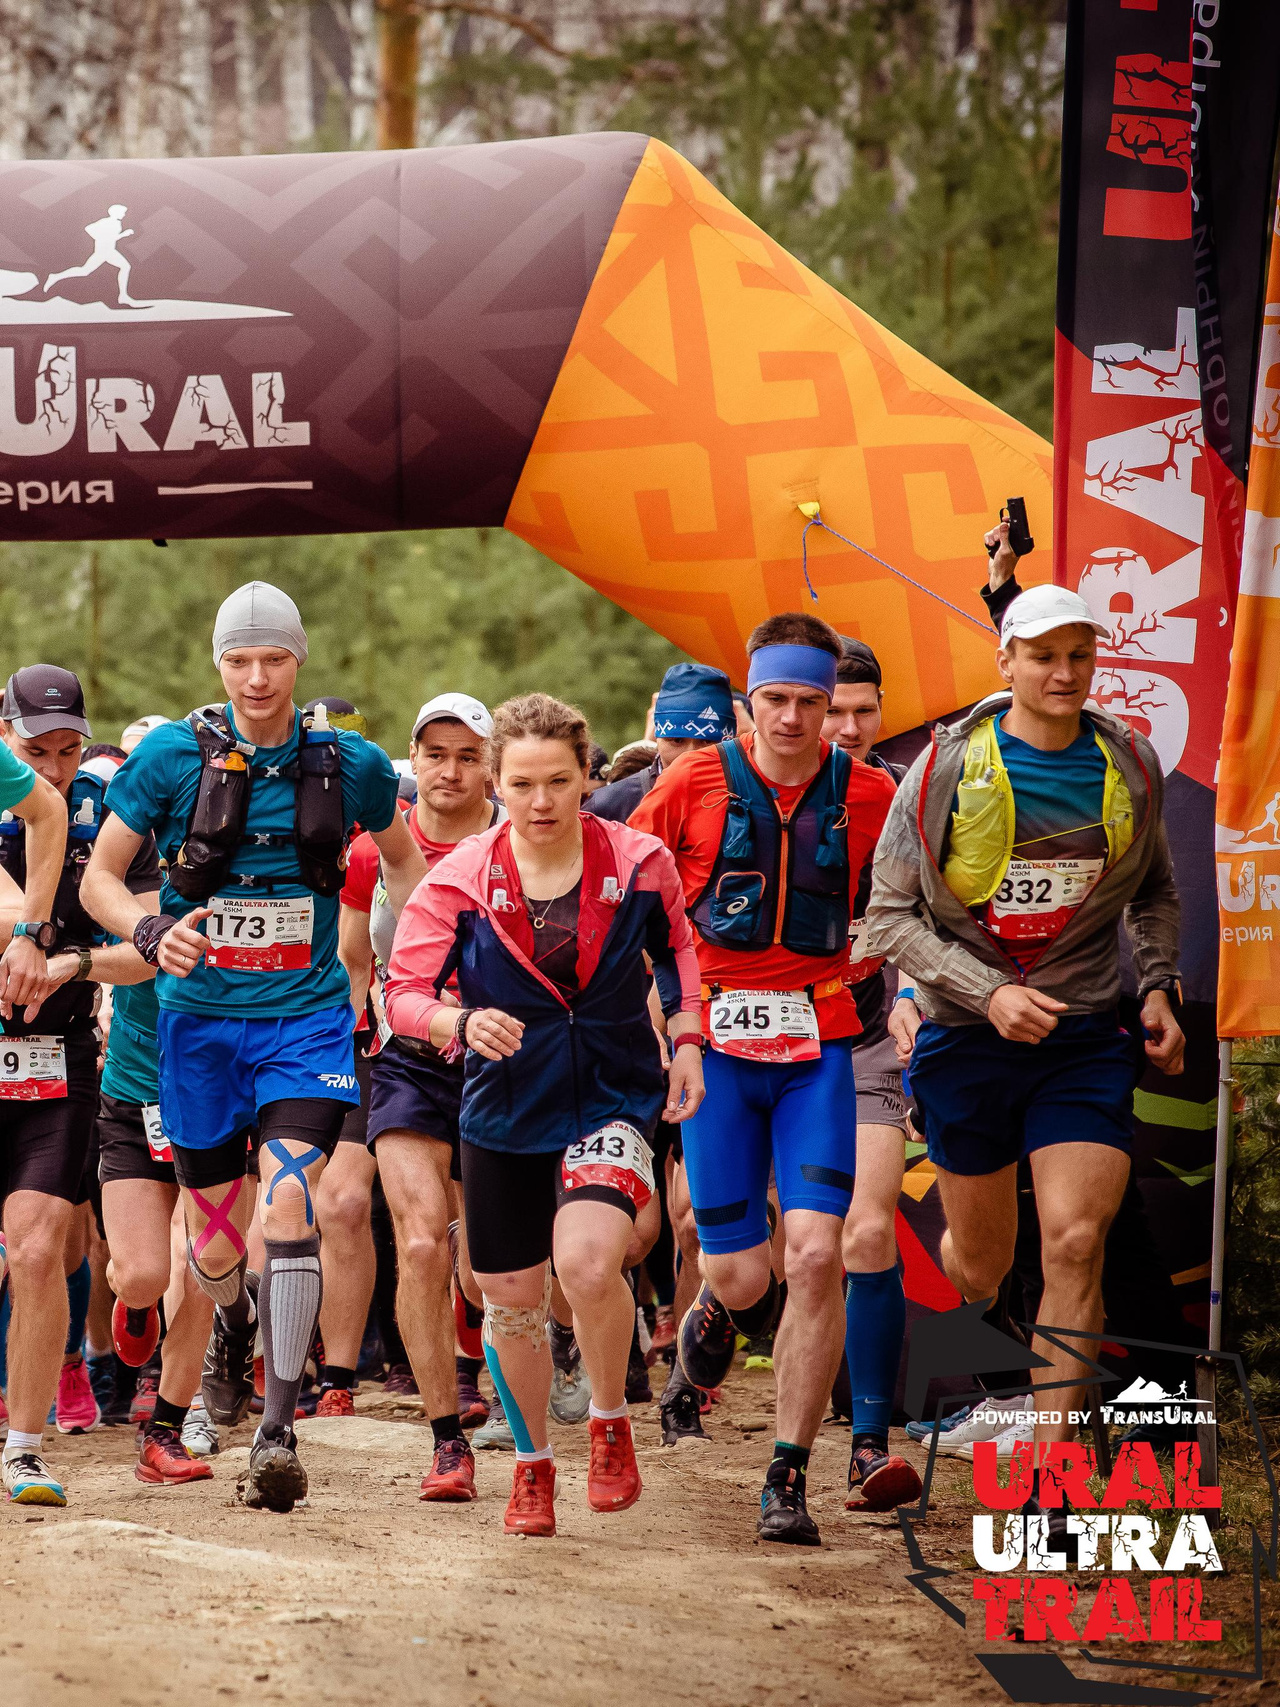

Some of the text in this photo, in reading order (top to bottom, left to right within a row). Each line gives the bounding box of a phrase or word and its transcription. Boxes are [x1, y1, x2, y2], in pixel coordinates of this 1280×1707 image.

[995, 878, 1053, 904] 332
[213, 914, 266, 939] 173
[1220, 926, 1274, 948] ерия
[727, 991, 748, 999] URAL
[714, 1006, 771, 1030] 245
[568, 1136, 626, 1159] 343
